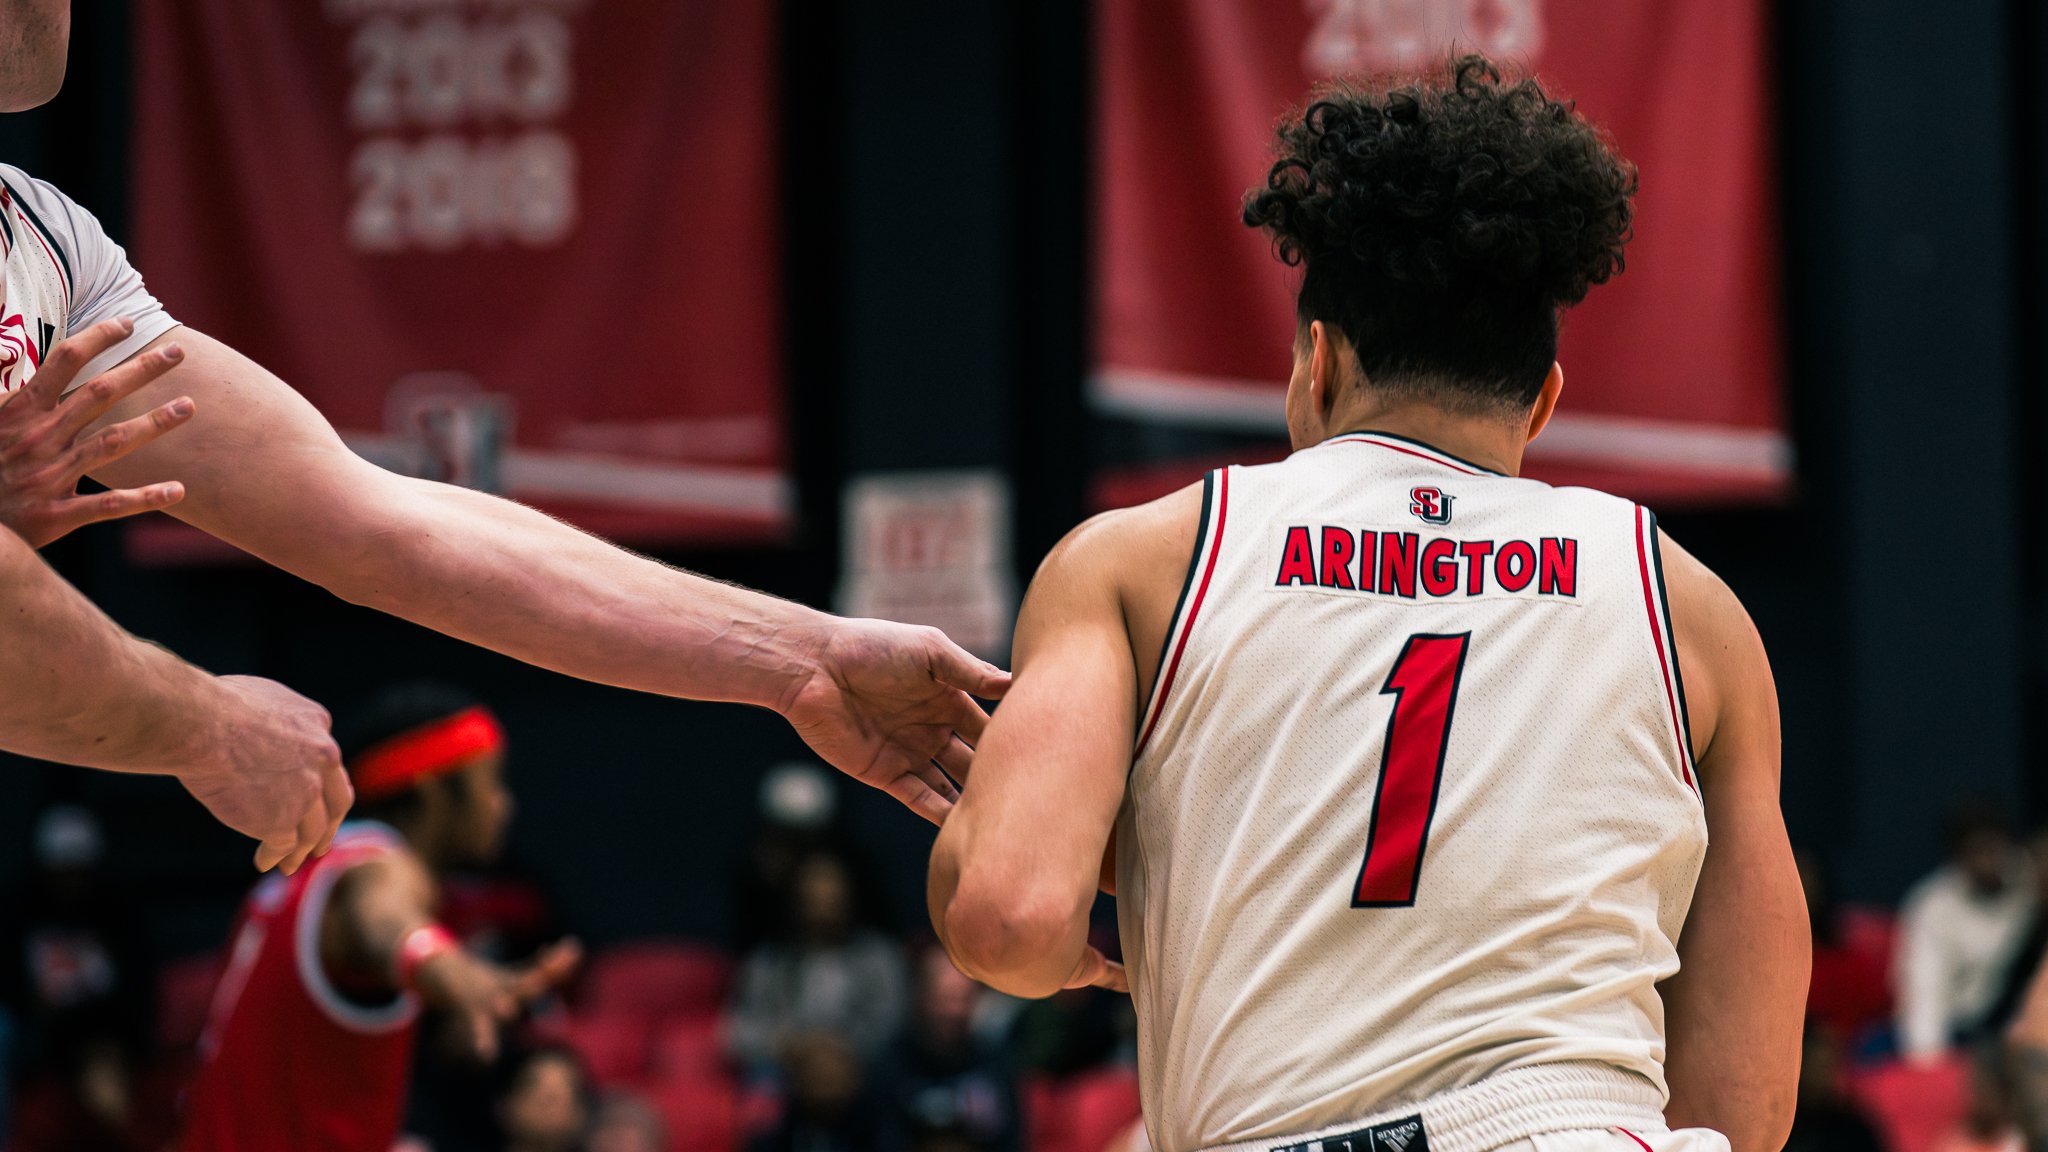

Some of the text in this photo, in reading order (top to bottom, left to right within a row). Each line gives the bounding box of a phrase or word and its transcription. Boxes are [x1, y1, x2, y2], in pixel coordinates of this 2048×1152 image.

[1275, 526, 1578, 599] ARINGTON
[1350, 630, 1472, 908] 1
[1376, 1121, 1419, 1141] adidas
